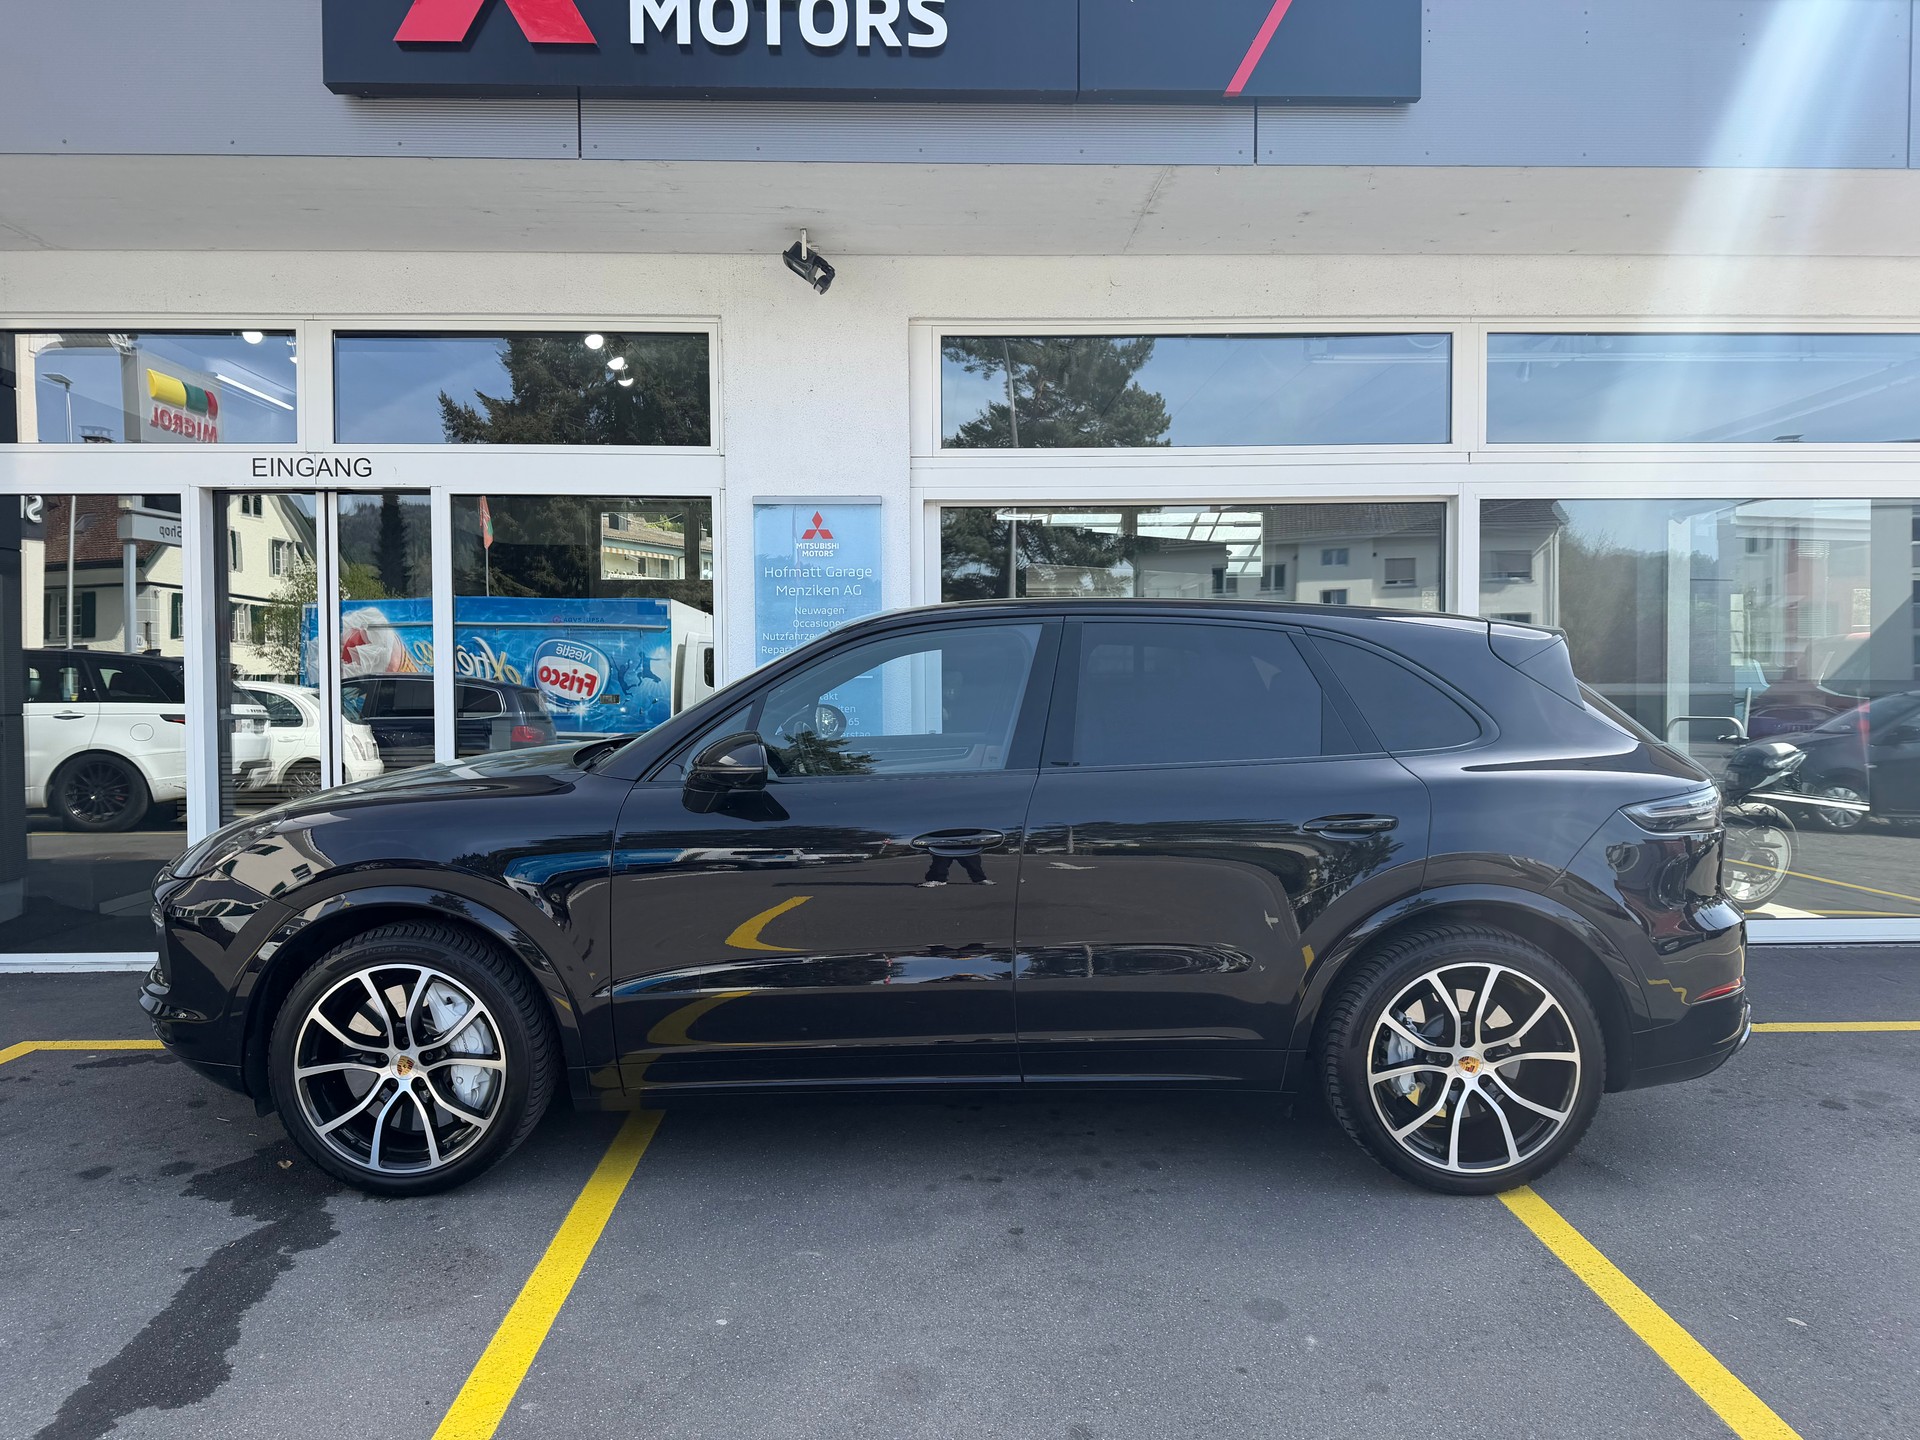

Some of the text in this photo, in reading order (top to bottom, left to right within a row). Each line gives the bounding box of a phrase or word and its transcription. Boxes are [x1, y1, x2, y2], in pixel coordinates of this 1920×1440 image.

[629, 0, 949, 48] MOTORS
[252, 457, 372, 478] EINGANG
[796, 542, 840, 550] MITSUBISHI
[764, 566, 873, 579] Hofmatt Garage
[776, 584, 862, 596] Menziken AG
[794, 606, 845, 617] Neuwagen
